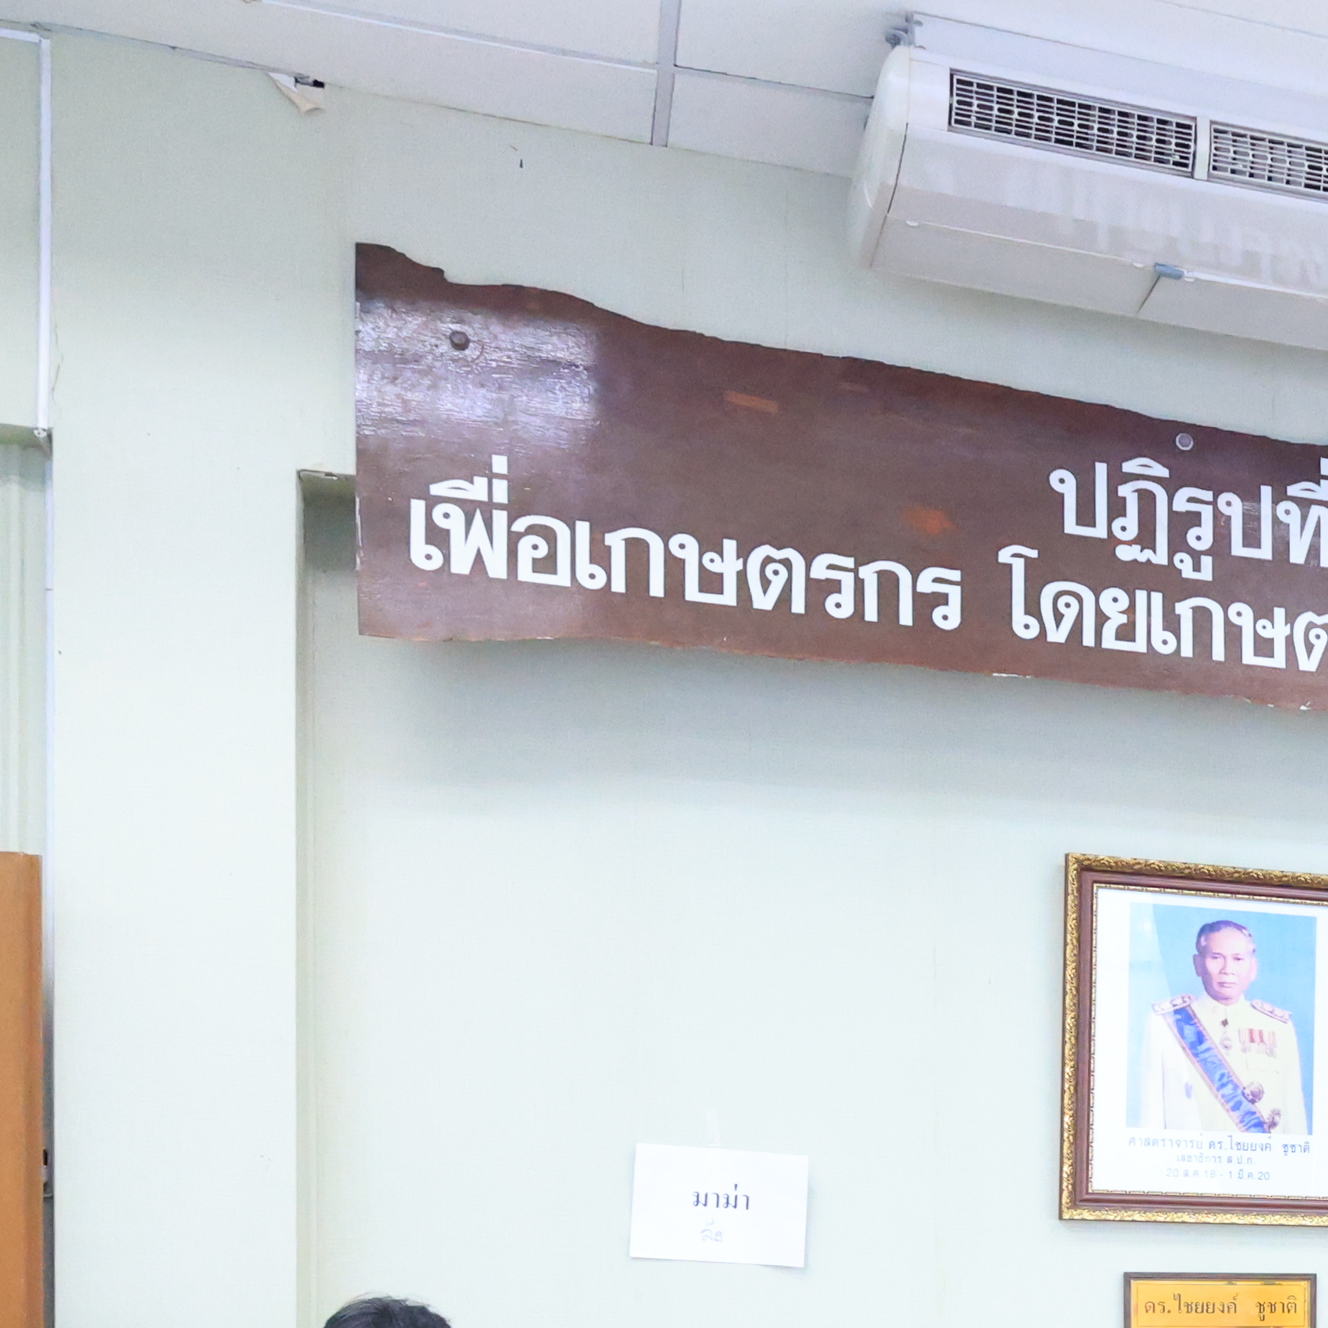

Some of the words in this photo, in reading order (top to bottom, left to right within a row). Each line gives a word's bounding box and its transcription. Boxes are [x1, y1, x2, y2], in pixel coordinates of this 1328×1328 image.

[408, 455, 965, 632] เพื่อเกษตรกร
[1208, 1135, 1273, 1153] ดร.ไชยยงค์
[1281, 1141, 1311, 1158] ชูชาติ
[1166, 1168, 1179, 1178] 20
[692, 1183, 751, 1210] มาม่า
[1144, 1292, 1238, 1314] ดร.ไชยยงค์
[1255, 1294, 1299, 1321] ชูชาติ
